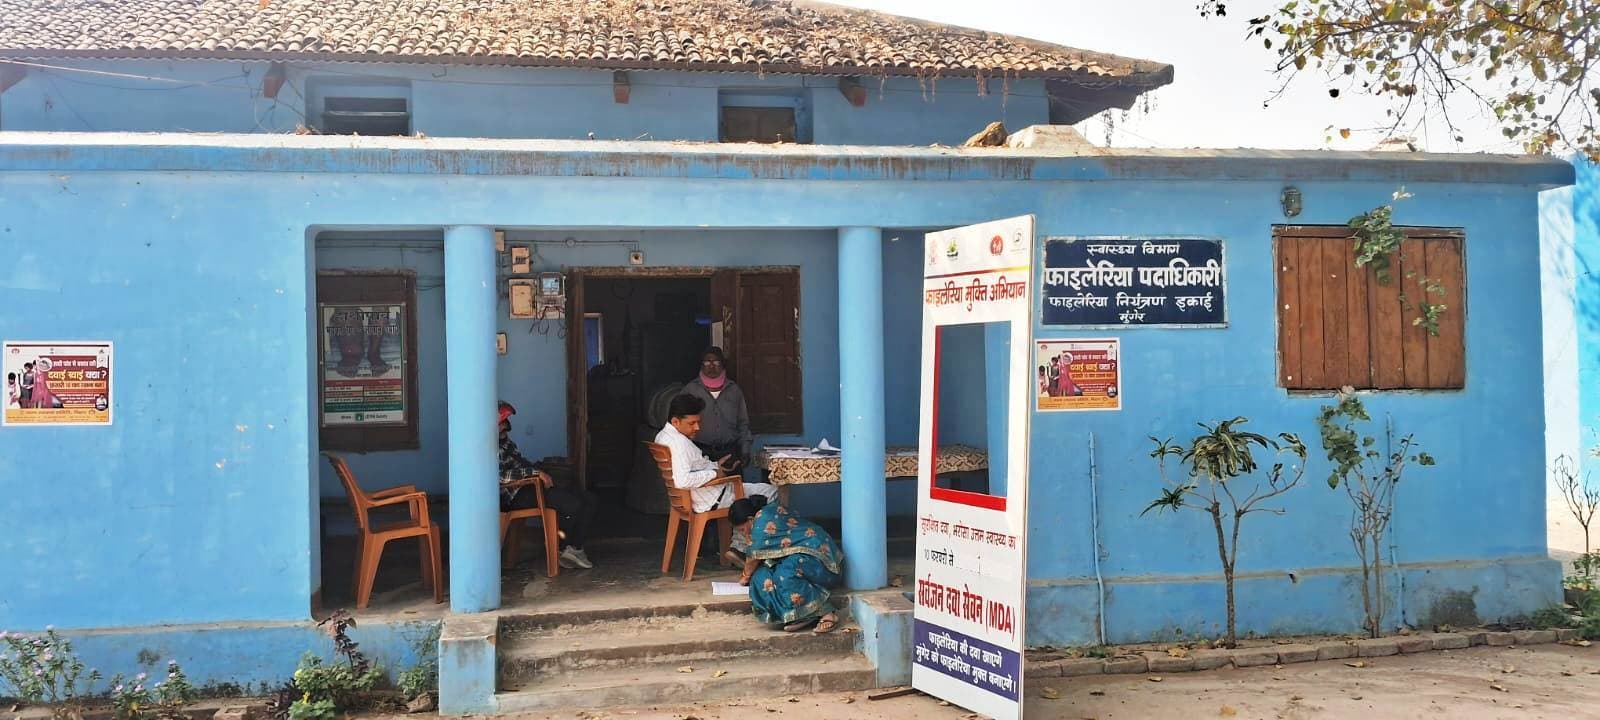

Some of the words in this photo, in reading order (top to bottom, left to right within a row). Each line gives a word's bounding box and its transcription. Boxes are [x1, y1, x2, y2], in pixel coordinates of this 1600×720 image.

[1044, 259, 1133, 290] फाइलेरिया
[1138, 258, 1221, 289] पदाधिकारी
[926, 280, 963, 307] फाइलेरिया
[965, 278, 987, 312] मुक्ति
[990, 276, 1026, 301] अभियान
[1048, 293, 1108, 311] फाइलेरिया
[1116, 292, 1167, 309] नियंत्रण
[1175, 292, 1213, 311] इकाई
[1119, 310, 1146, 324] मुंगेर
[48, 370, 65, 380] दवाई
[68, 370, 83, 380] खाई
[953, 520, 969, 539] भरोसा
[971, 527, 984, 542] उत्तम
[986, 531, 1006, 546] स्वास्थ्य
[1008, 536, 1016, 550] का
[931, 547, 947, 565] फरवरी
[949, 550, 954, 567] से
[919, 573, 943, 612] सर्वजन
[946, 587, 960, 618] दवा
[963, 584, 983, 624] सेवन
[986, 600, 1016, 642] (MDA)
[928, 631, 958, 653] फाइलेरिया
[960, 640, 968, 656] की
[969, 645, 980, 661] दवा
[916, 642, 929, 663] मुंगेर
[931, 648, 939, 664] को
[940, 654, 971, 675] फाइलेरिया
[972, 666, 987, 684] मुक्त
